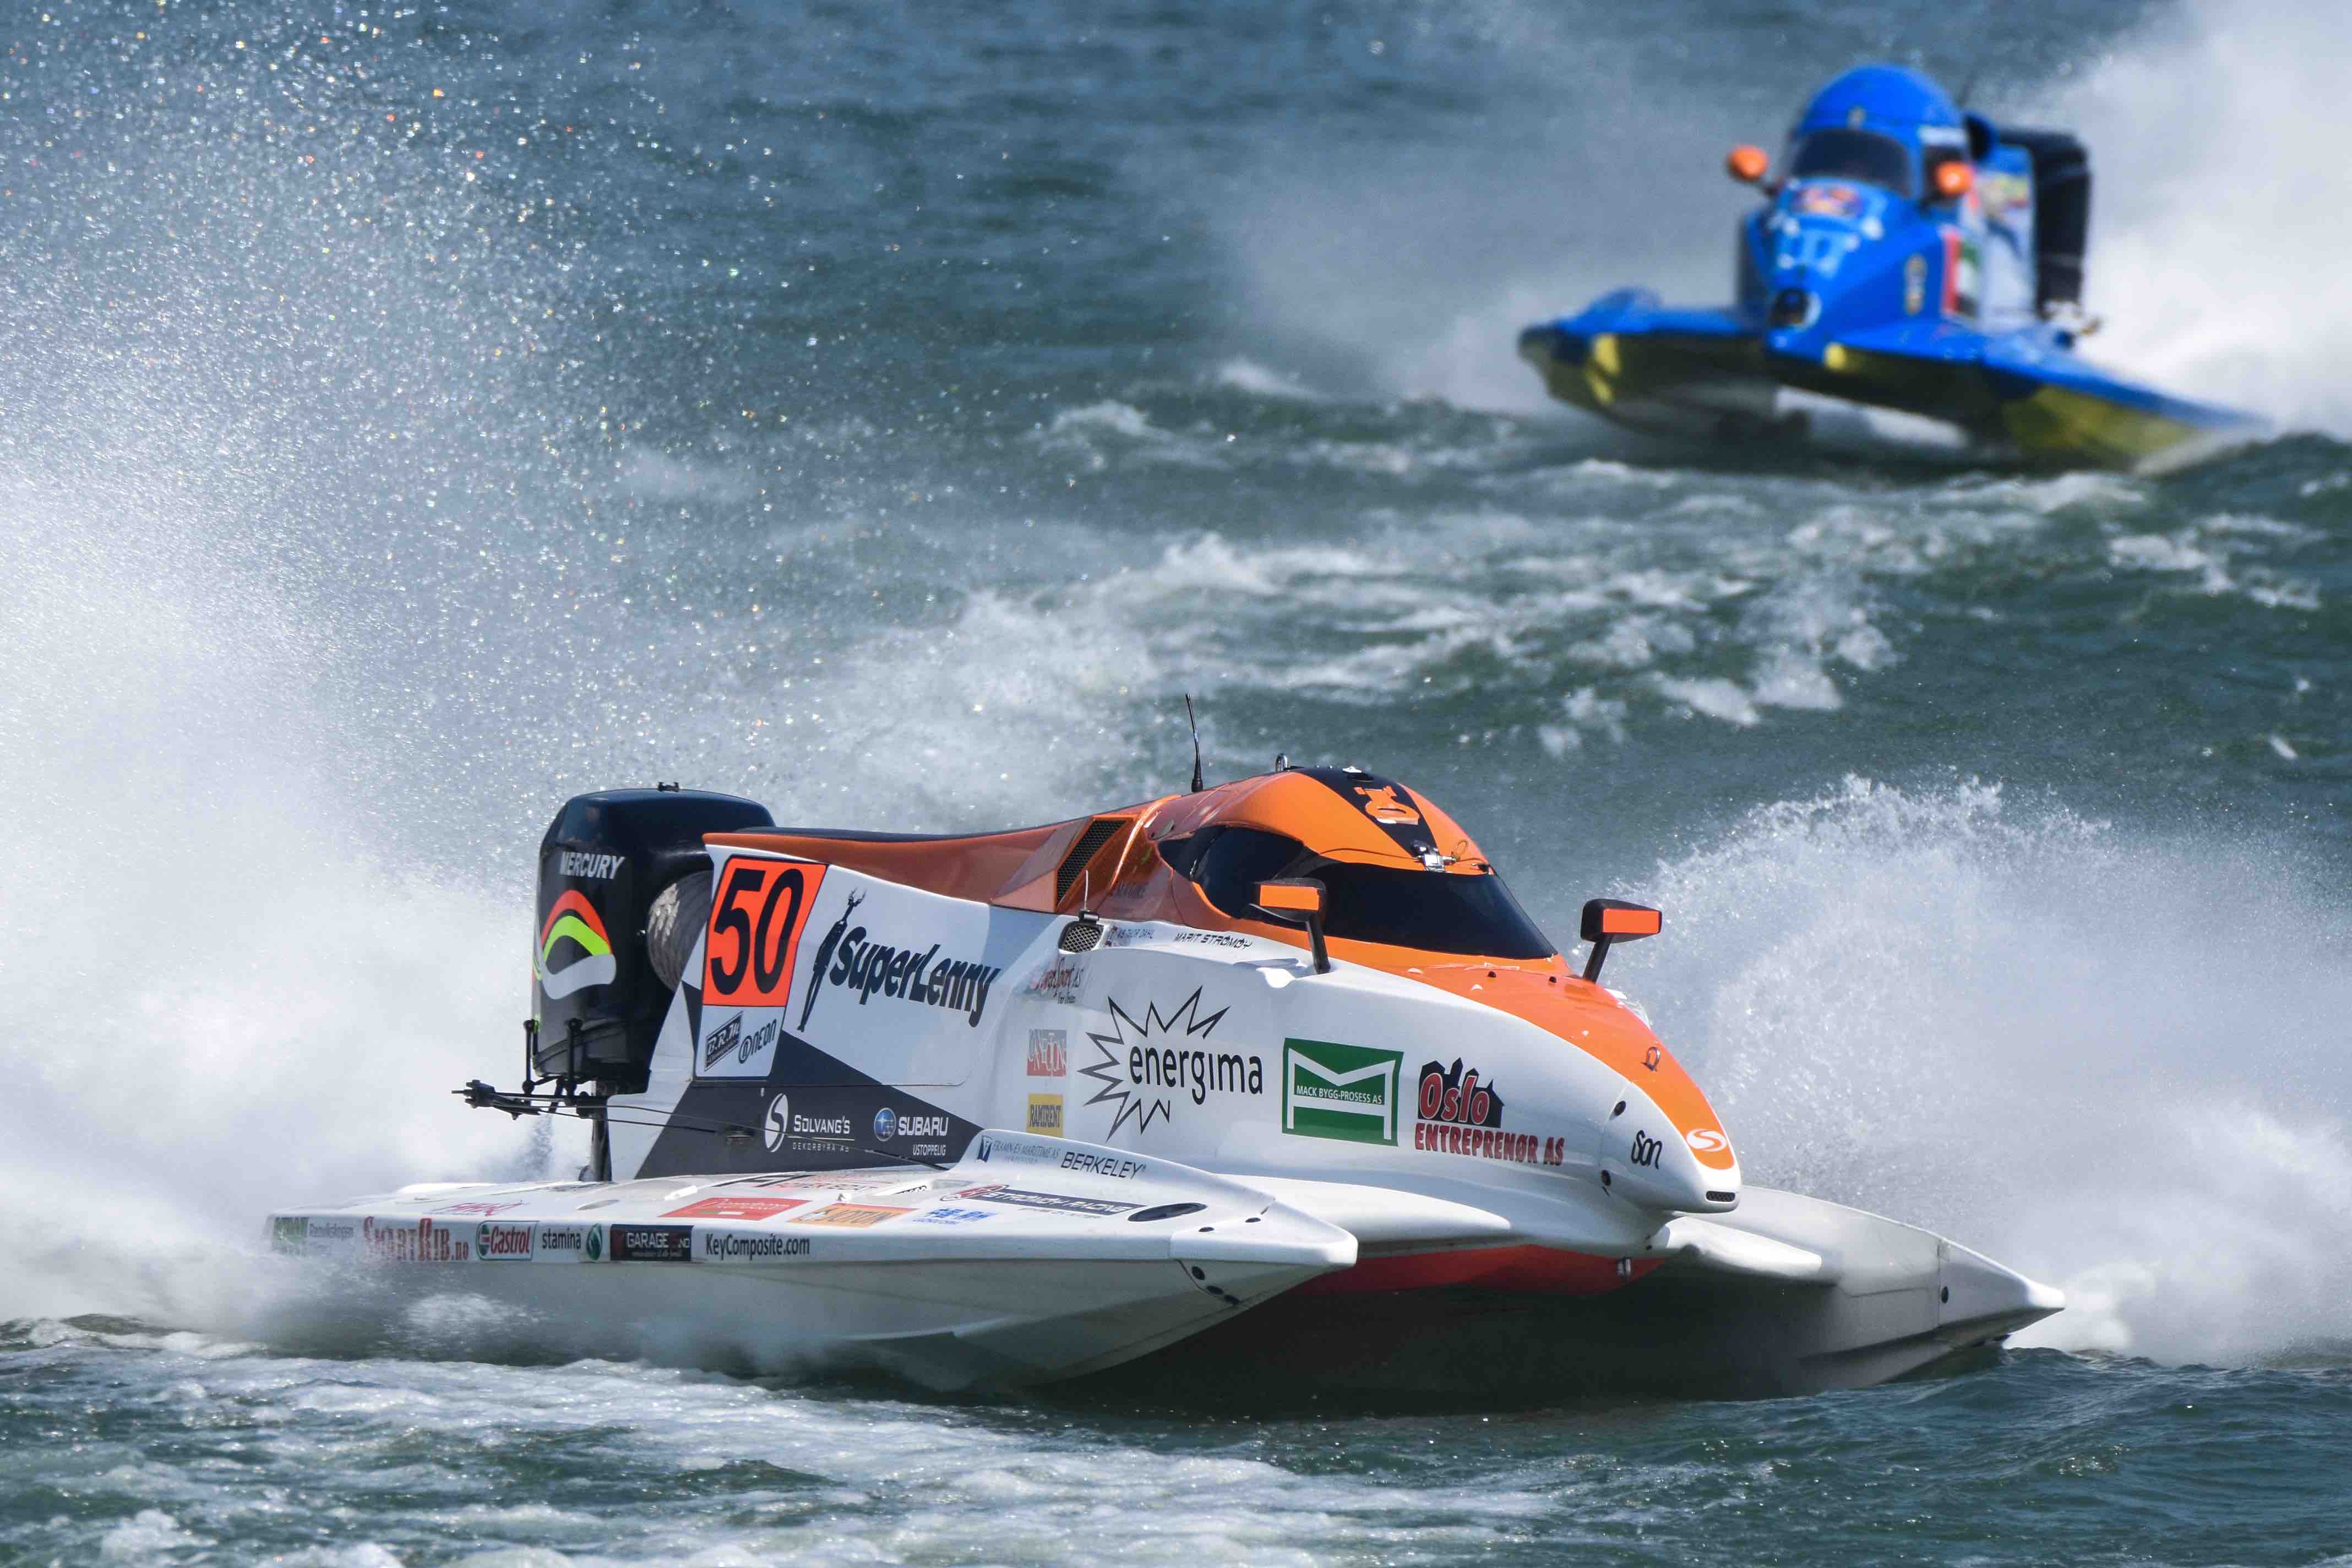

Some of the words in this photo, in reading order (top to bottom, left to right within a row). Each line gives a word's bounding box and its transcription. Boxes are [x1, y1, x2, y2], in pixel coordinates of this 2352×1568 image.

[560, 851, 625, 879] MERCURY
[711, 868, 803, 995] 50
[829, 927, 1001, 1027] SuperLenny
[1129, 1046, 1263, 1105] energima
[1296, 1085, 1317, 1097] MACK
[1319, 1088, 1370, 1103] BYGG-PROSESS
[1373, 1094, 1382, 1104] AS
[1419, 1072, 1490, 1125] Oslo
[793, 1115, 851, 1135] SOLVANG'S
[898, 1117, 949, 1137] SUBARU
[1030, 1104, 1061, 1128] RAMIRENT
[912, 1144, 946, 1157] USTOPPELIG
[1414, 1123, 1538, 1163] ENTREPRENØR
[1543, 1136, 1565, 1166] AS
[1060, 1151, 1144, 1179] BERKELEY
[491, 1226, 531, 1254] Castrol
[542, 1231, 581, 1250] stamina
[706, 1234, 810, 1261] KeyComposite.com
